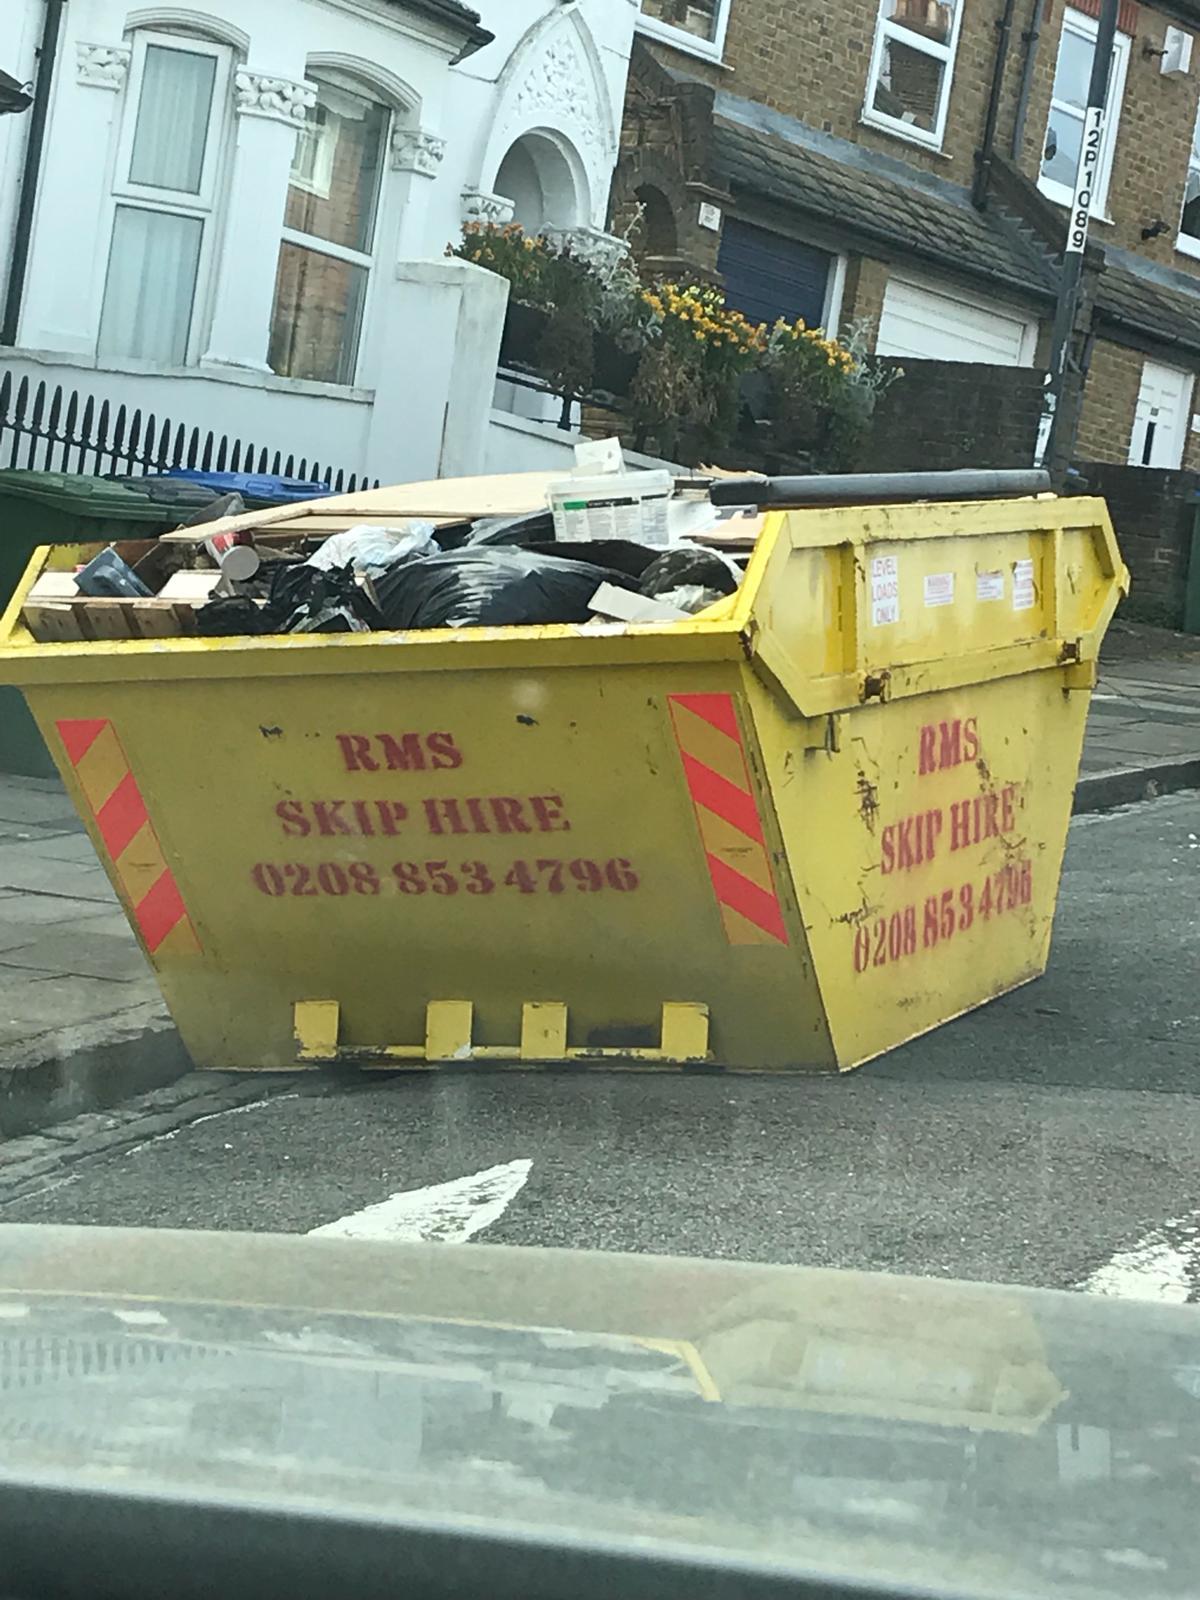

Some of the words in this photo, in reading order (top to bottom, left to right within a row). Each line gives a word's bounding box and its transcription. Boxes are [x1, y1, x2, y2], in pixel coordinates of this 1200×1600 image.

[1072, 110, 1102, 248] 12P1089
[872, 582, 897, 601] LOADS
[336, 732, 464, 771] RMS
[917, 717, 979, 776] RMS
[275, 799, 407, 837] SKIP
[423, 795, 571, 834] HIRE
[880, 808, 943, 875] SKIP
[950, 787, 1016, 851] HIRE
[251, 861, 380, 896] 0208
[392, 860, 496, 895] 853
[504, 857, 640, 894] 4796
[854, 905, 917, 974] 0208
[923, 883, 974, 949] 853
